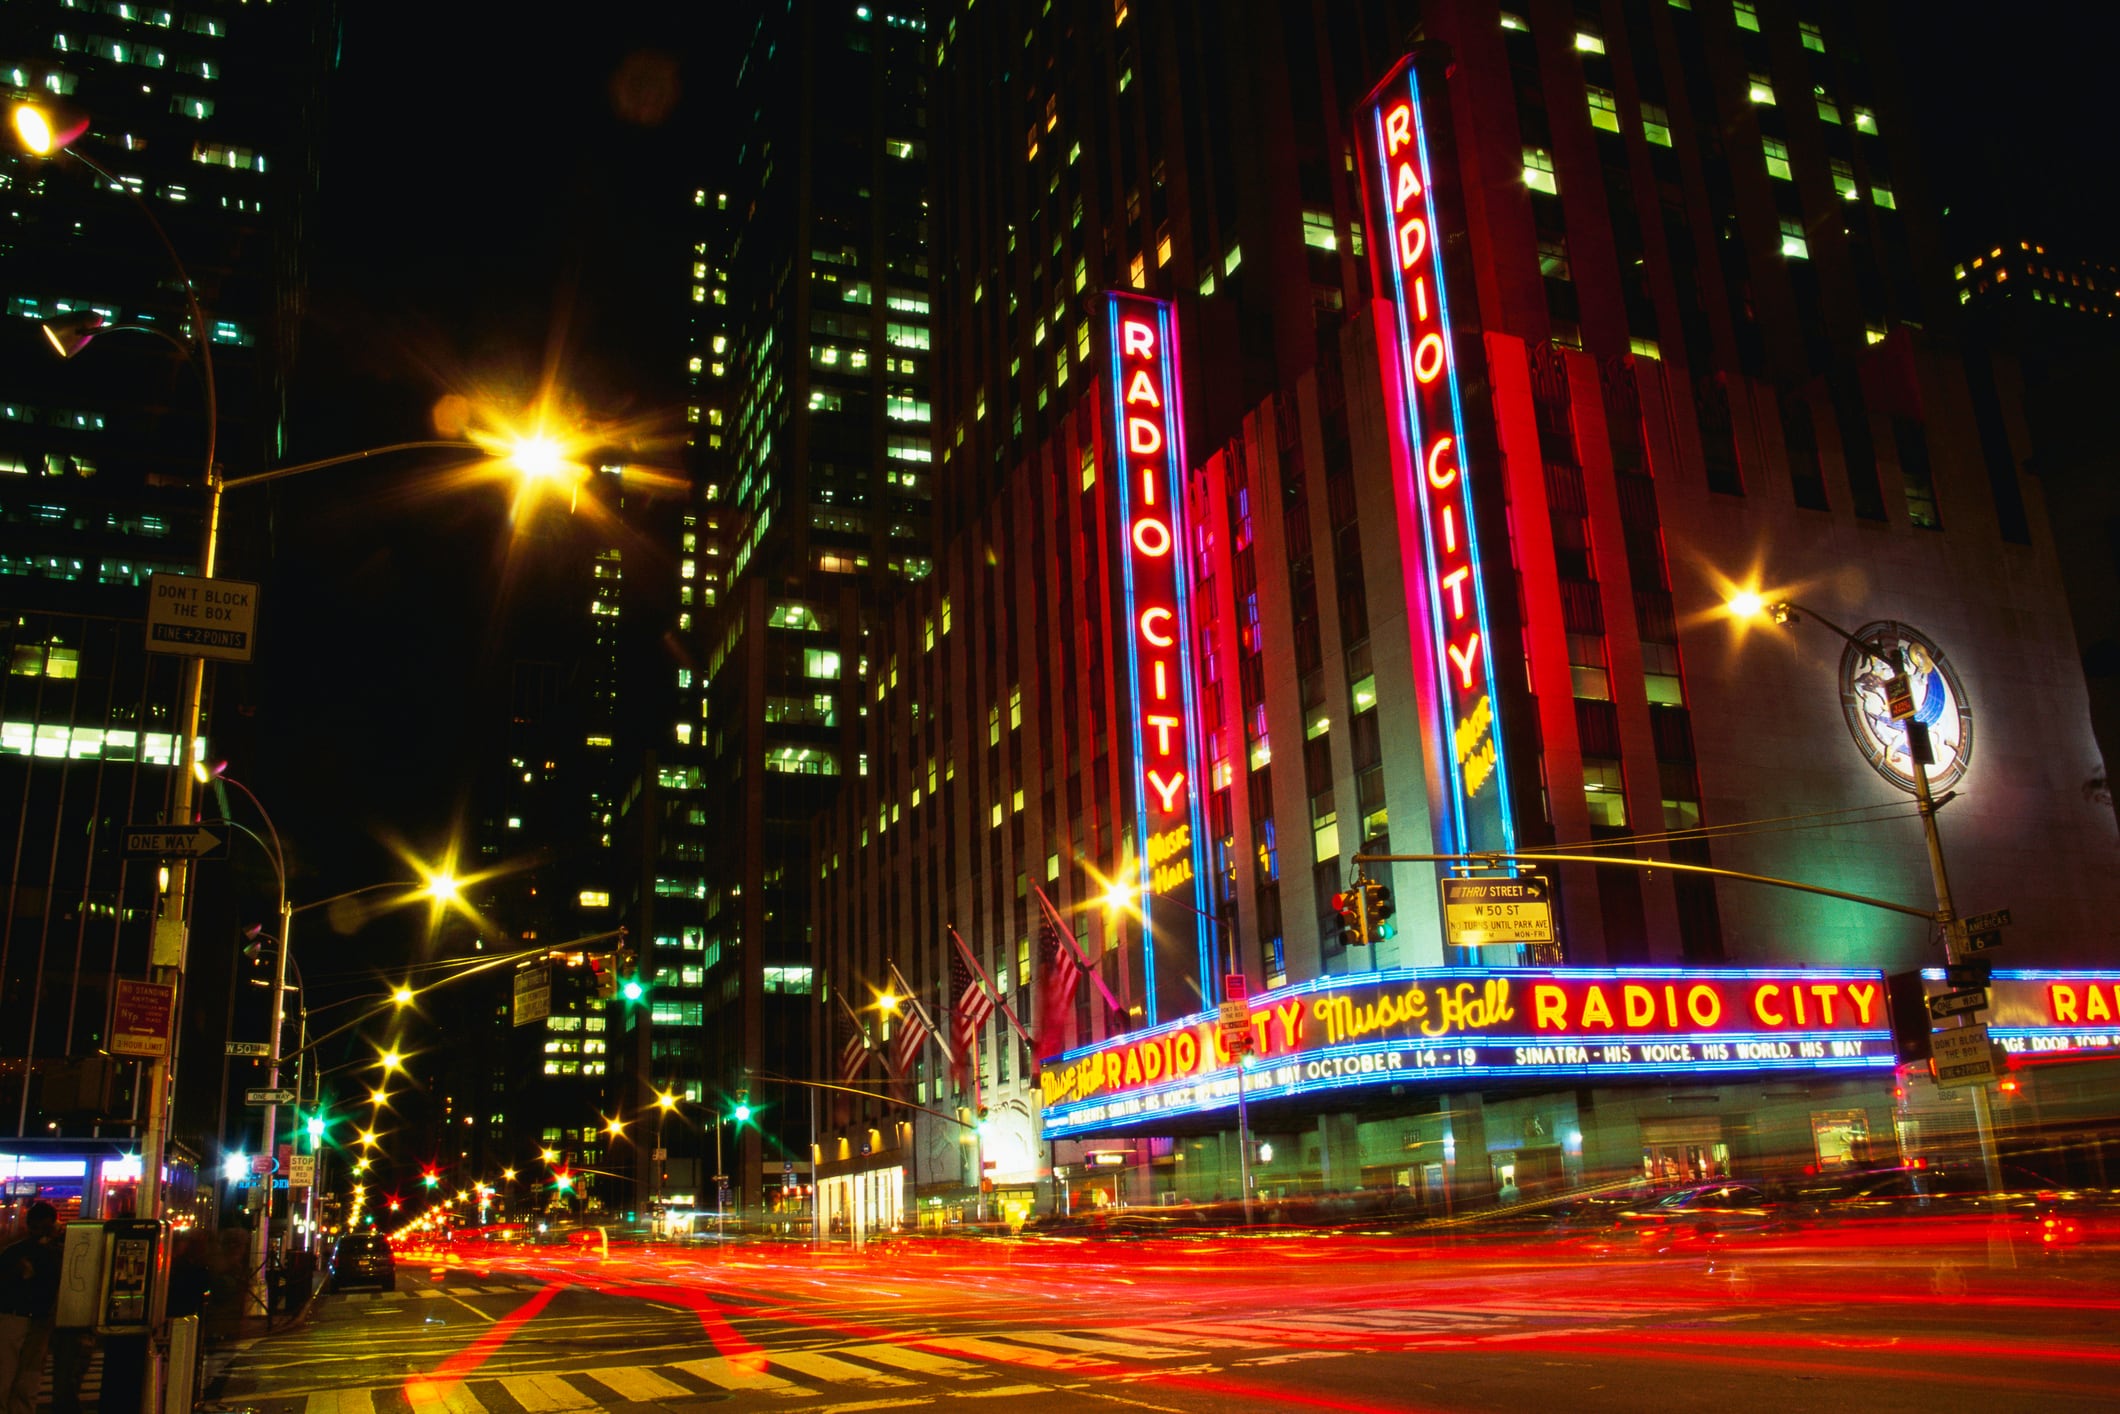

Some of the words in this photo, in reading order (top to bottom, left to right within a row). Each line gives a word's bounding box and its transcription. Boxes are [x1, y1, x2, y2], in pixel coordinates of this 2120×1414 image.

[1385, 104, 1444, 384] RADIO
[1428, 436, 1479, 690] CITY
[1124, 320, 1171, 558] RADIO
[158, 585, 198, 600] DON'T
[205, 590, 248, 607] BLOCK
[173, 603, 198, 618] THE
[205, 607, 232, 621] BOX
[158, 626, 181, 640] FINE
[203, 631, 241, 647] POINTS
[1140, 606, 1185, 813] CITY
[131, 835, 160, 849] ONE
[164, 835, 195, 849] WAY
[1461, 886, 1487, 897] THRU
[1489, 885, 1523, 897] STREET
[1475, 906, 1483, 916] W
[1487, 905, 1502, 916] 50
[1507, 905, 1520, 916] ST
[1491, 920, 1512, 930] UNTIL
[1514, 920, 1533, 929] PARK
[1535, 919, 1548, 929] AVE
[2051, 984, 2120, 1022] RA
[1106, 1032, 1196, 1089] RADIO
[1214, 999, 1301, 1063] CTY
[1313, 988, 1428, 1044] Music
[1420, 977, 1515, 1037] Hall
[1534, 985, 1721, 1030] RADIO
[1754, 983, 1875, 1026] CITY
[1934, 1037, 1957, 1050] DON'T
[1959, 1033, 1985, 1044] BLOCK
[226, 1044, 235, 1053] W
[237, 1044, 251, 1054] 50
[2031, 1036, 2069, 1051] DOOR
[1945, 1047, 1960, 1059] THE
[1963, 1046, 1977, 1057] BOX
[1255, 1070, 1272, 1089] HIS
[1307, 1052, 1402, 1080] OCTOBER
[1416, 1049, 1436, 1068] 14
[1457, 1048, 1477, 1066] 19
[1515, 1046, 1589, 1065] SINATRA
[1603, 1045, 1632, 1063] HIS
[1702, 1043, 1729, 1060] HIS
[1800, 1041, 1825, 1058] HIS
[1830, 1040, 1863, 1057] WAY
[292, 1157, 314, 1165] STOP
